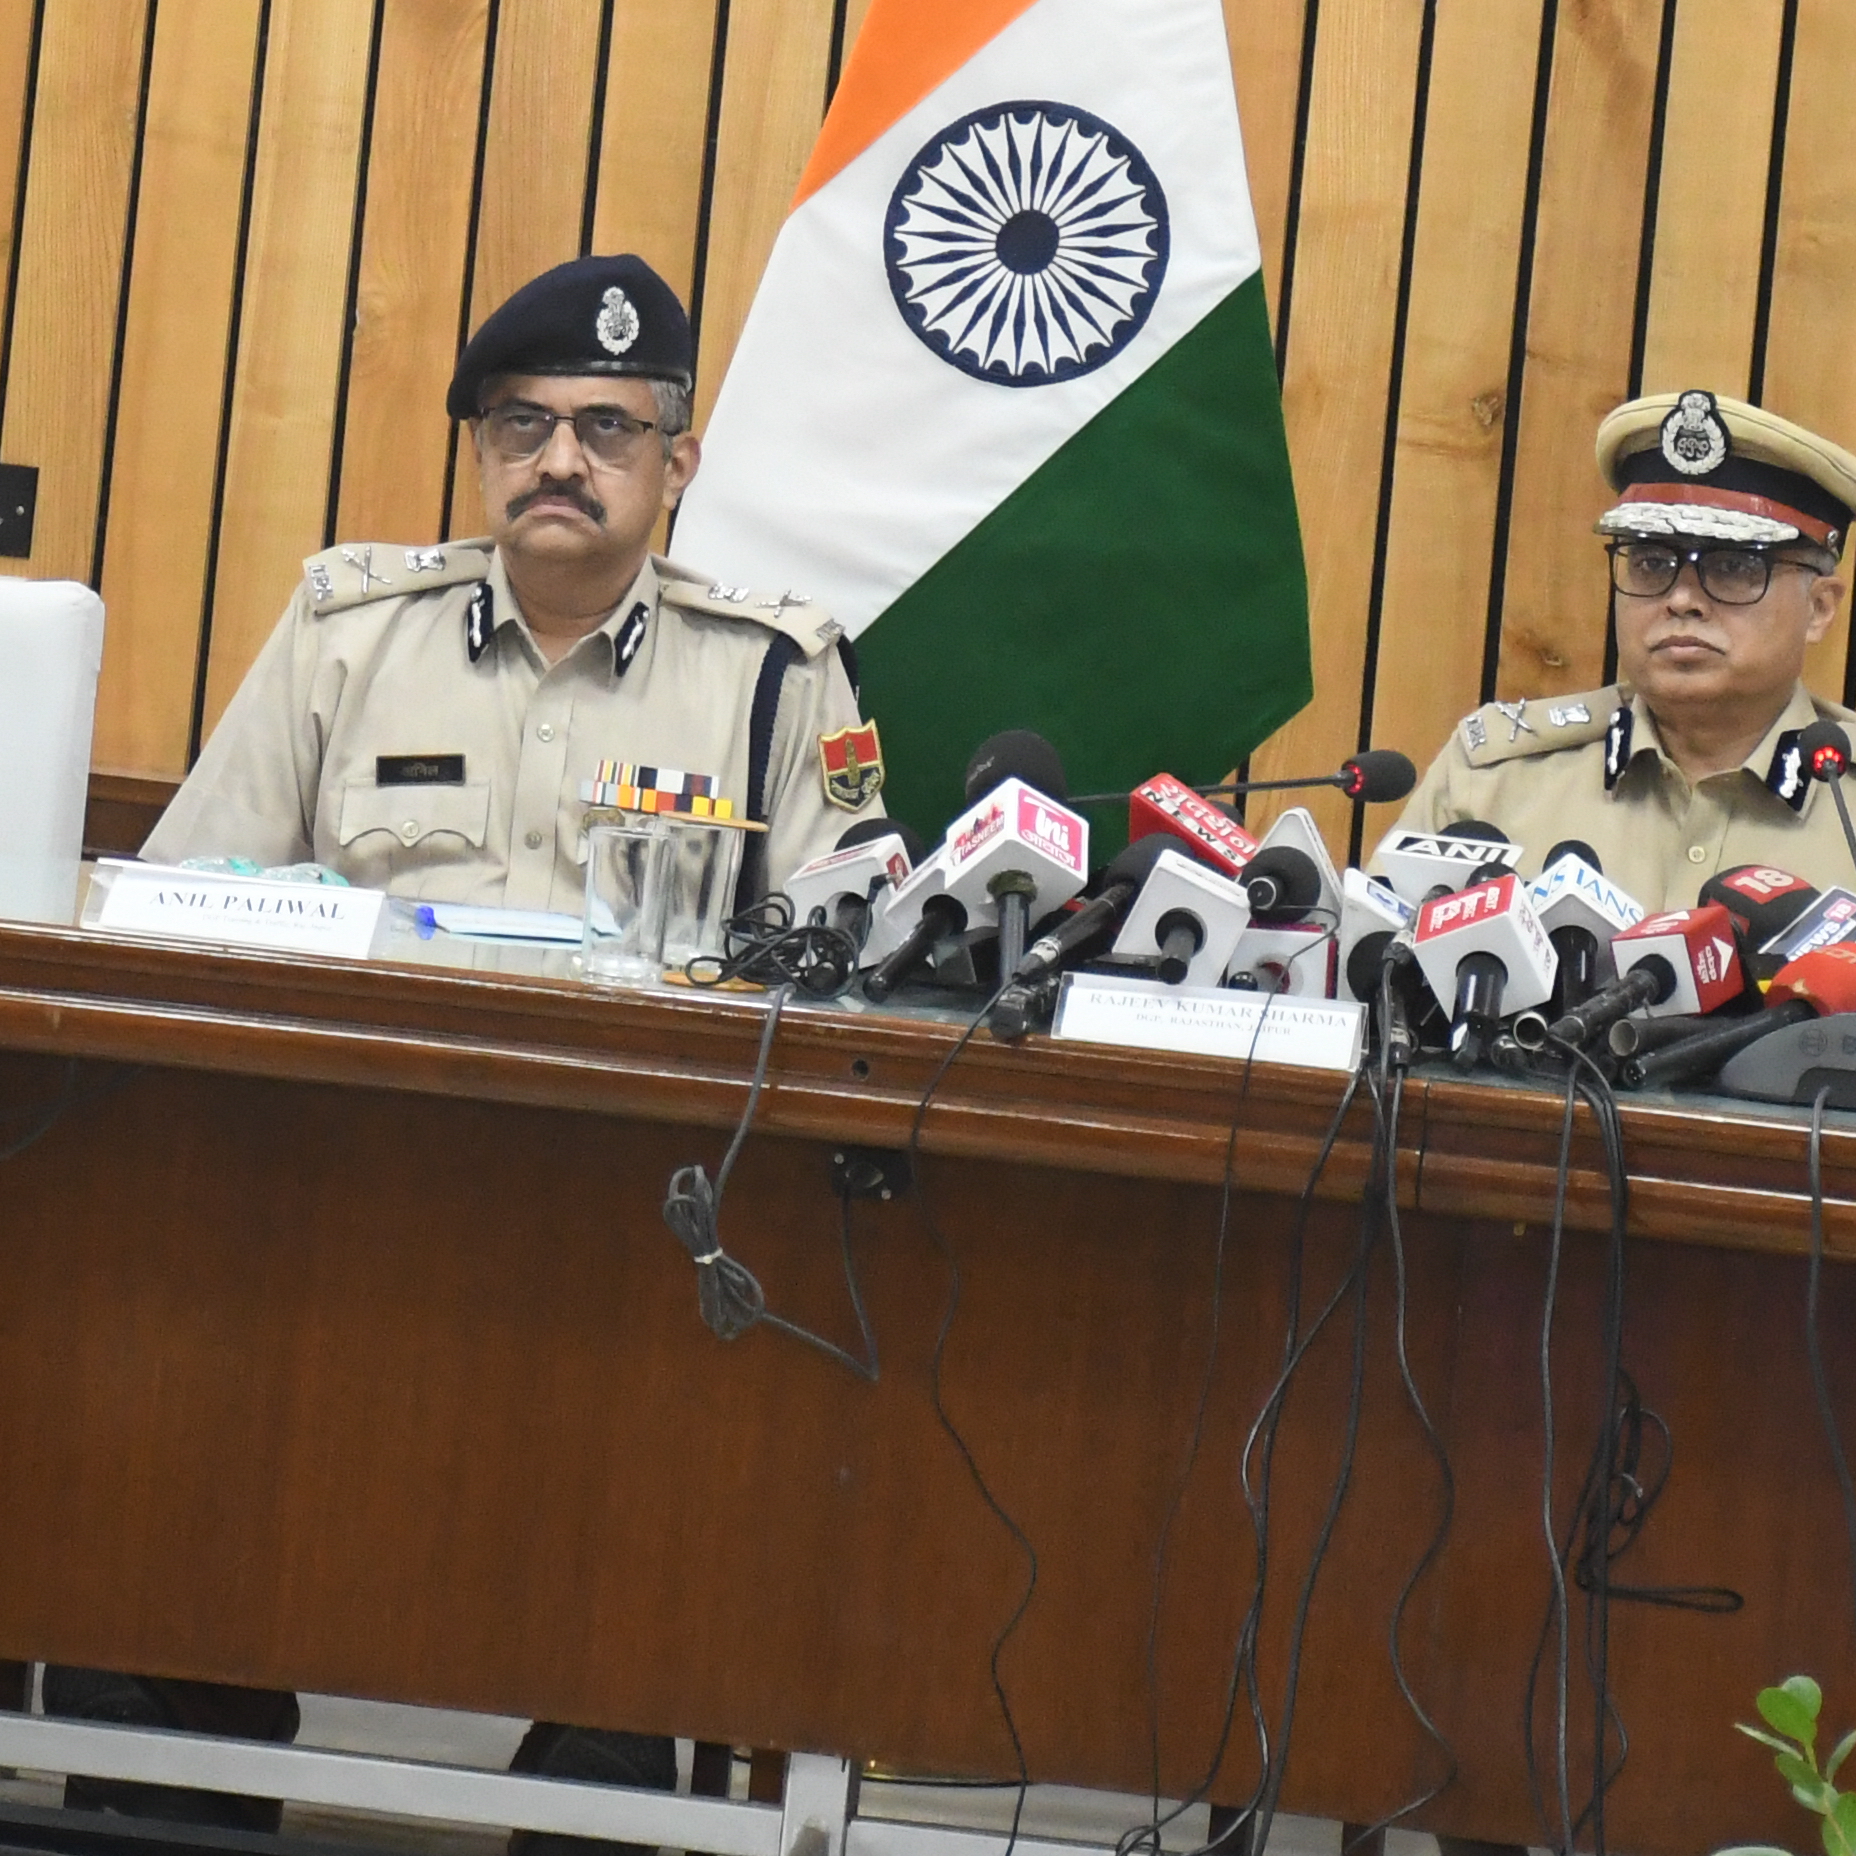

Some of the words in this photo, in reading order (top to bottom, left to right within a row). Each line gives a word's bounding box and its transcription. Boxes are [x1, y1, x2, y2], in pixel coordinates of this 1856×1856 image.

[1146, 791, 1238, 861] NEWS
[1403, 839, 1503, 863] ANI
[1734, 869, 1795, 894] 18
[149, 891, 213, 909] ANIL
[223, 895, 346, 920] PALIWAL
[1429, 886, 1501, 932] PTI
[1576, 868, 1644, 925] IANS
[1829, 903, 1853, 919] 18
[1090, 992, 1175, 1009] RAJEEV
[1176, 999, 1253, 1019] KUMAR
[1258, 1006, 1348, 1028] SHARMA
[1246, 1022, 1292, 1037] JIPUR
